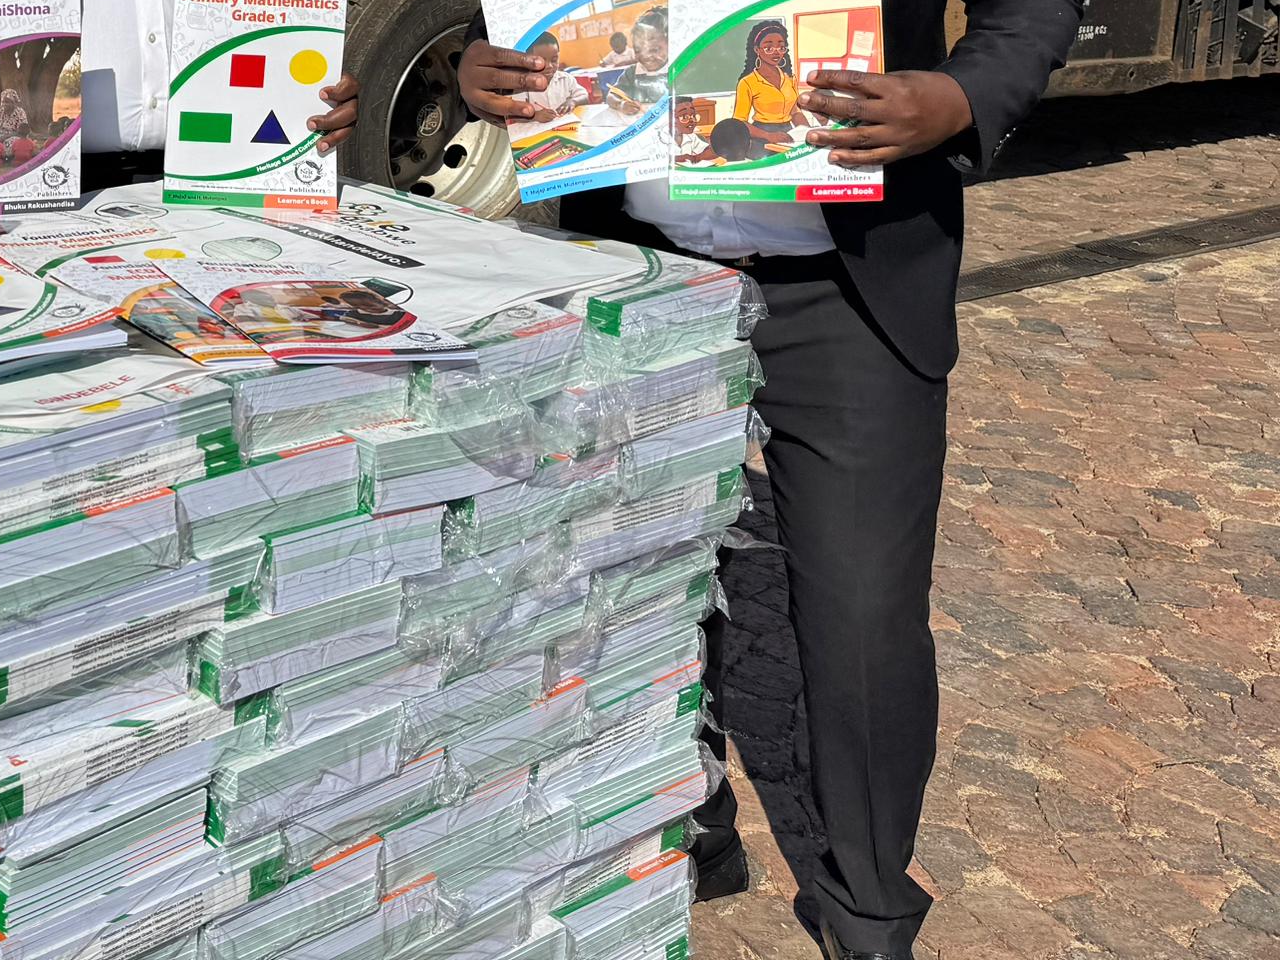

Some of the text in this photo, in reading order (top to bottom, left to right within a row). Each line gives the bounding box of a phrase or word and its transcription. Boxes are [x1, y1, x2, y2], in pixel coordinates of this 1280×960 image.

[231, 9, 287, 24] Grade 1
[256, 160, 281, 172] Heritage
[812, 188, 852, 196] Learner's
[0, 227, 158, 249] Primary Mathematics
[22, 229, 99, 241] Foundation
[197, 261, 275, 269] Foundation
[253, 268, 304, 276] English
